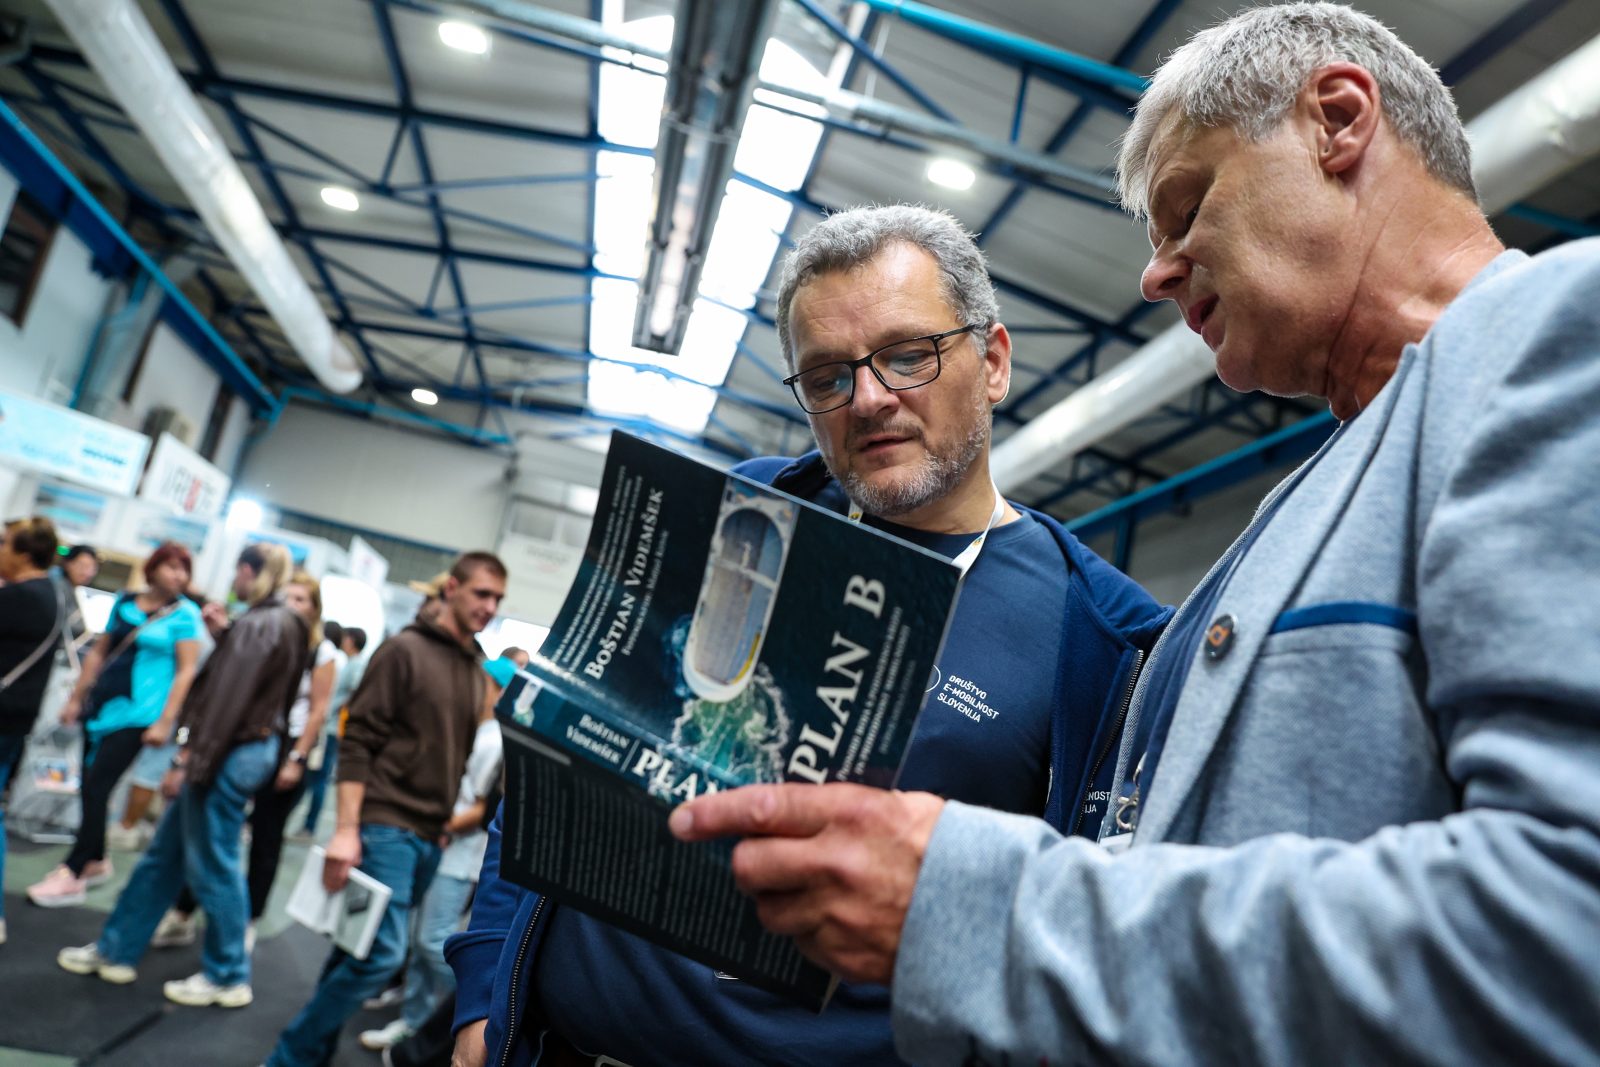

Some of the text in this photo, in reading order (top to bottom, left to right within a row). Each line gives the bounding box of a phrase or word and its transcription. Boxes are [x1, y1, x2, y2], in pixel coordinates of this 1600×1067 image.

[584, 592, 636, 680] BOŠTJAN
[624, 488, 664, 584] VIDEMŠEK
[789, 574, 884, 783] PLAN B
[948, 674, 987, 700] DRUŠTVO
[937, 692, 981, 723] SLOVENIJA
[943, 683, 1000, 720] E-MOBILNOST
